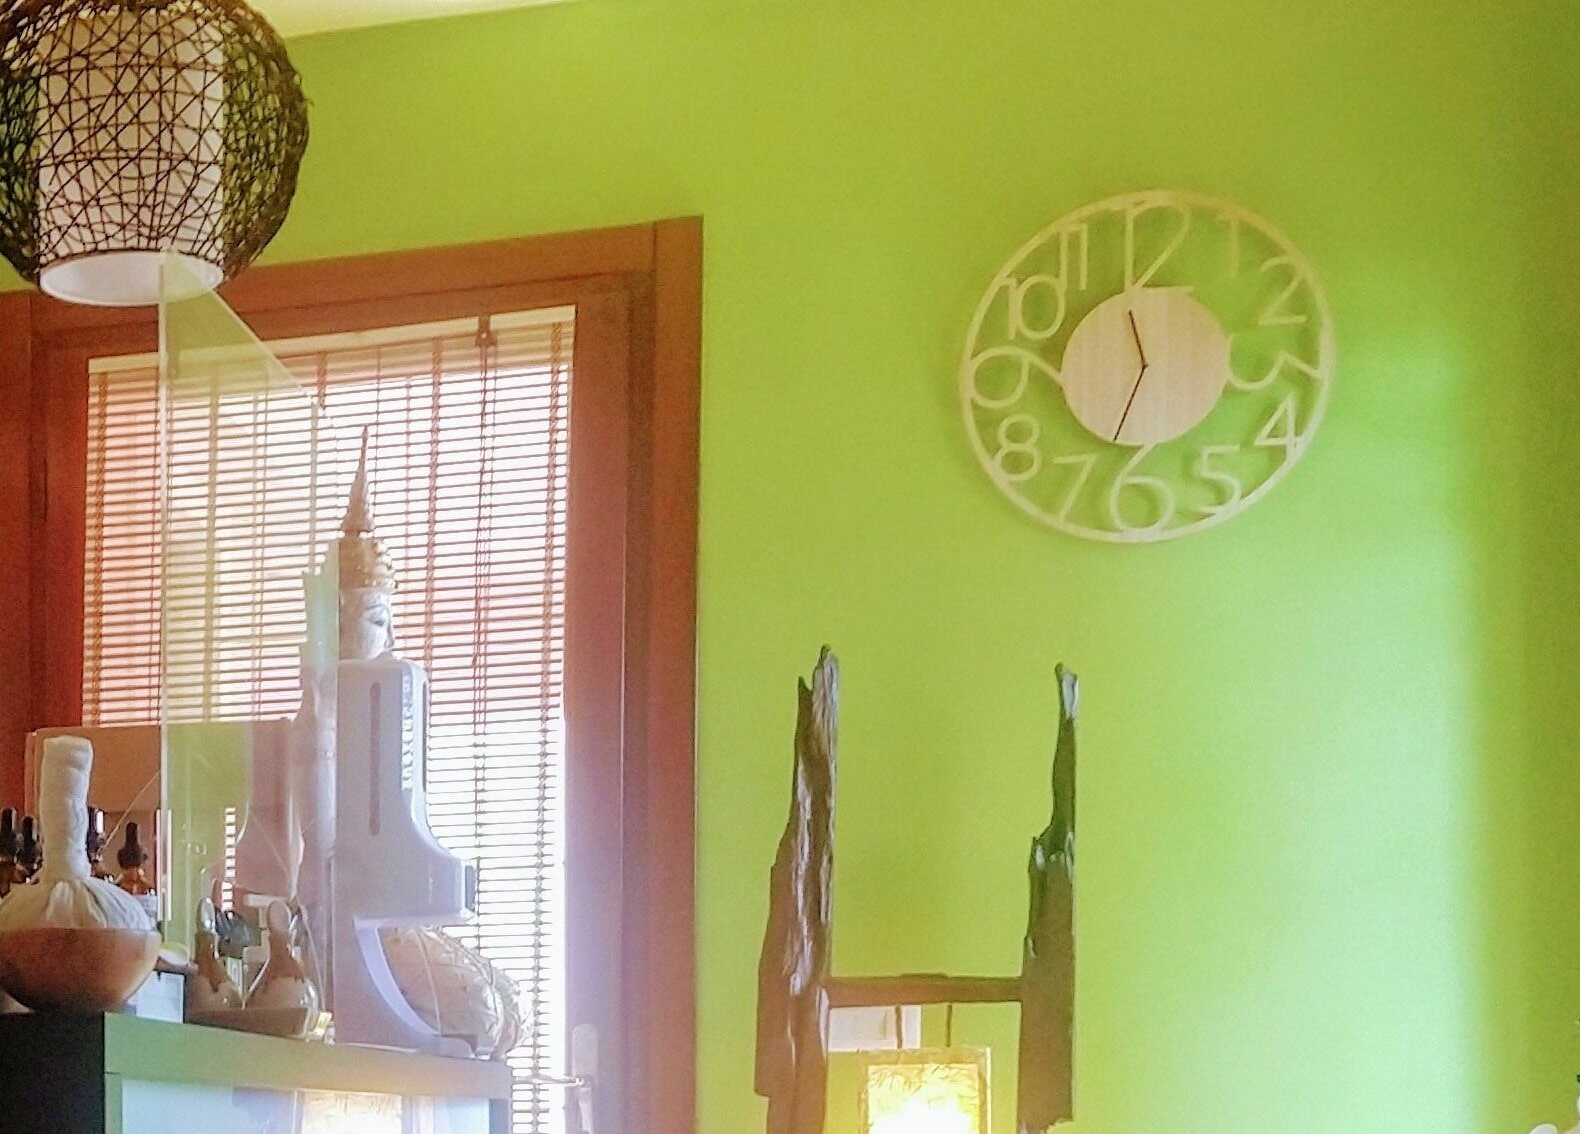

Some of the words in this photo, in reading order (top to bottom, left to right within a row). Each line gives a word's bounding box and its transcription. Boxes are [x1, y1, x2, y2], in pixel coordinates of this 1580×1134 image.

[1055, 223, 1087, 294] 11
[1124, 201, 1194, 293] 12
[996, 274, 1066, 340] 10
[1257, 257, 1306, 326] 2
[970, 345, 1066, 409] 9
[1226, 333, 1320, 390] 3
[995, 413, 1043, 481] 8
[1254, 392, 1304, 462] 4
[1052, 454, 1099, 524] 7
[1109, 443, 1176, 534] 6
[1197, 445, 1242, 517] 5
